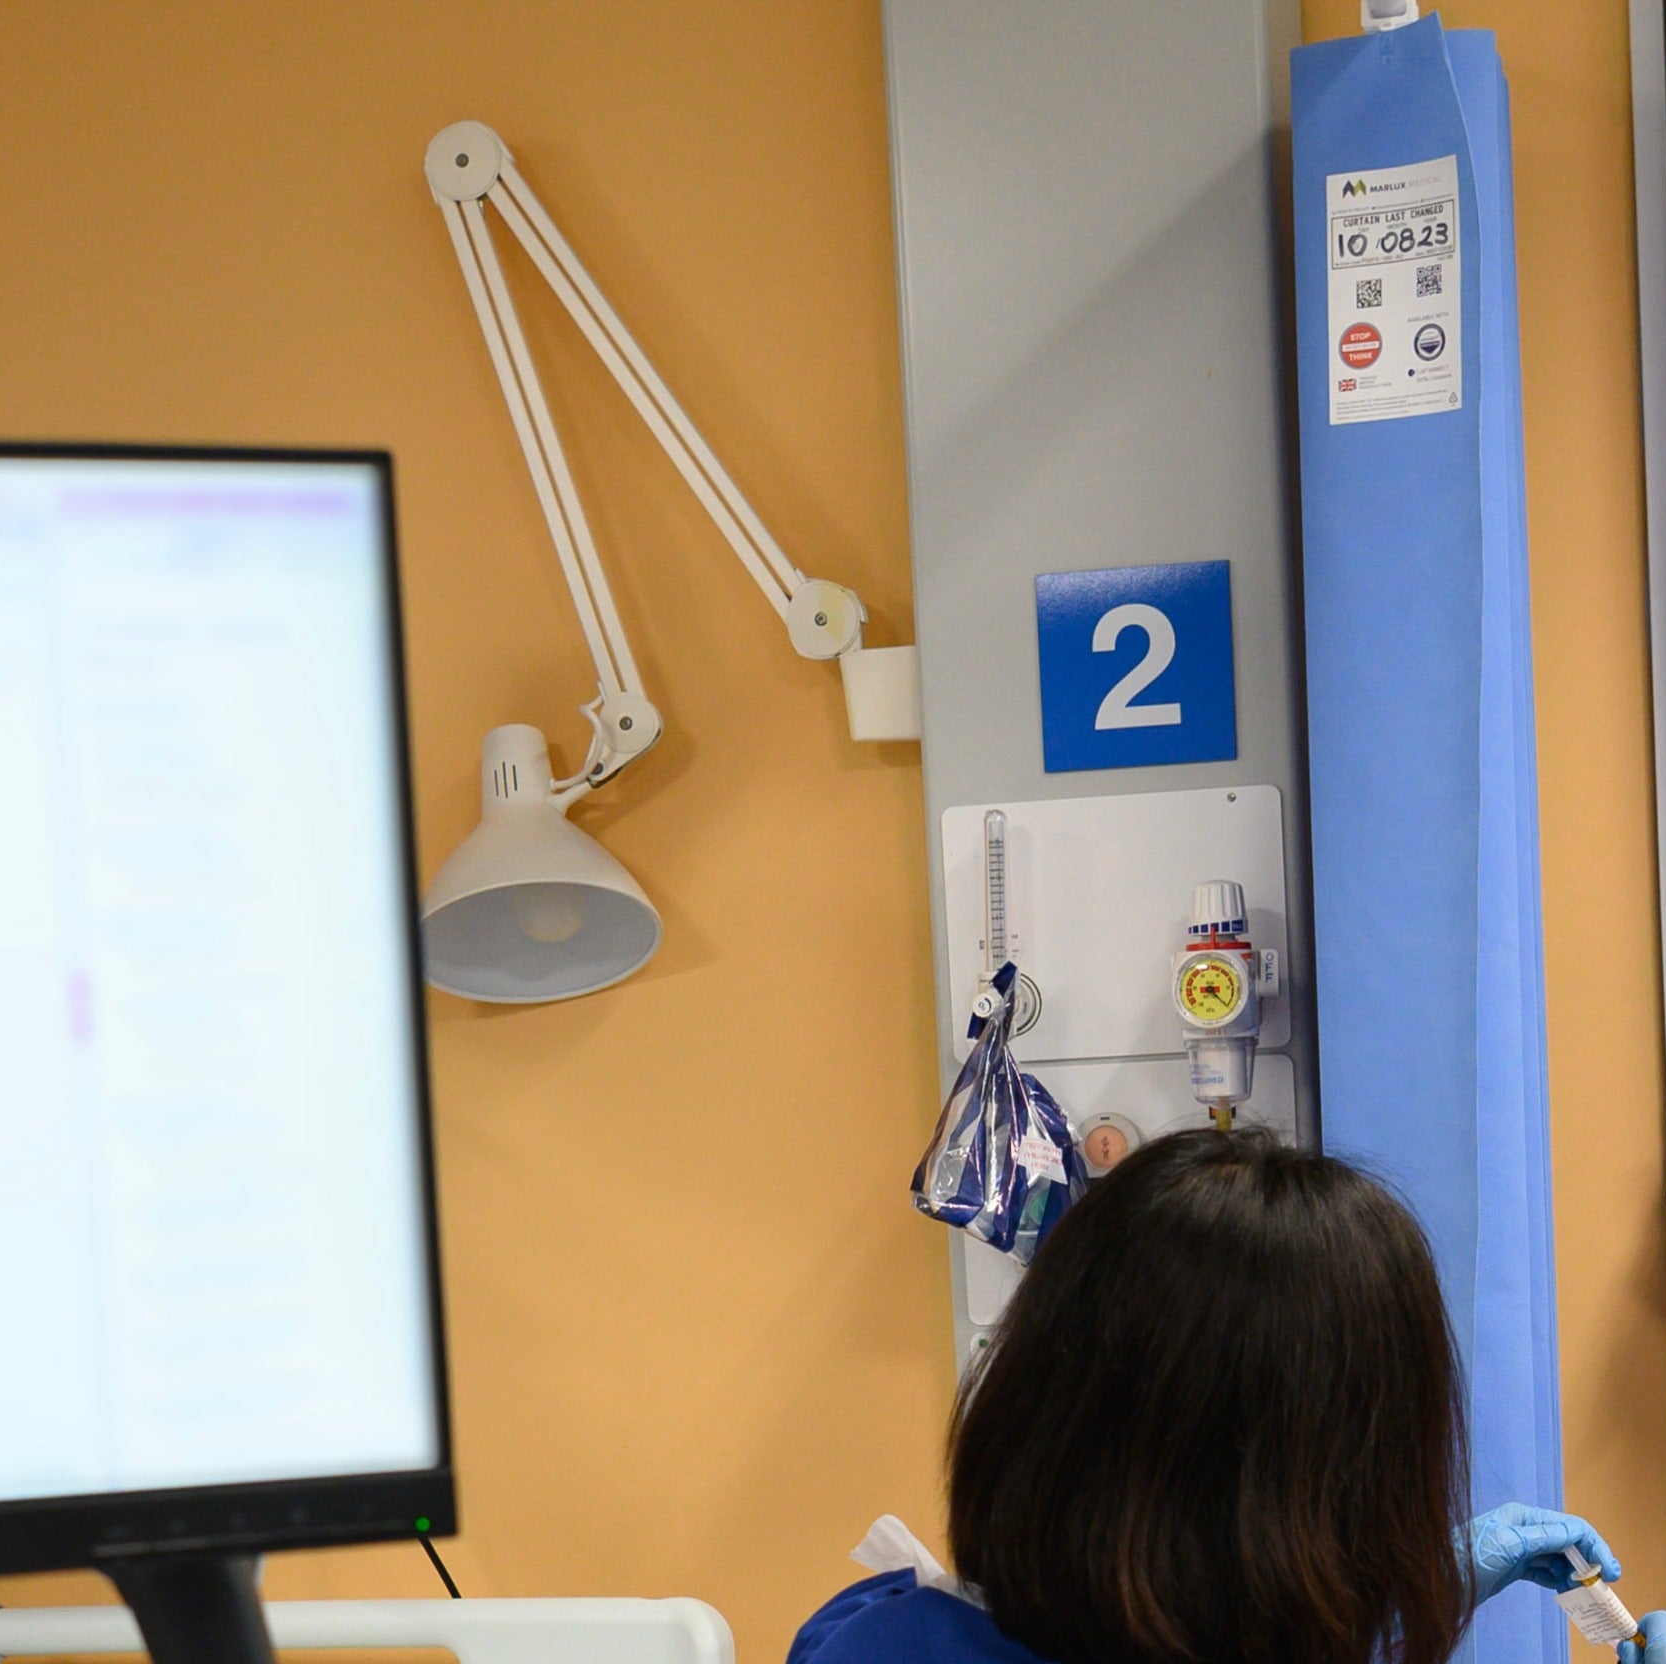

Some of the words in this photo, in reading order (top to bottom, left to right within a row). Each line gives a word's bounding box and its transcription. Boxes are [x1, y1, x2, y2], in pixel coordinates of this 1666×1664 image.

[1370, 182, 1406, 193] MARLUX
[1343, 215, 1380, 227] CURTAIN
[1385, 211, 1406, 222] LAST
[1410, 205, 1444, 219] CHANGED
[1338, 233, 1368, 258] 10
[1417, 222, 1449, 248] 23
[1350, 332, 1371, 341] STOP
[1349, 352, 1373, 361] THINK
[1091, 604, 1182, 731] 2
[1265, 952, 1274, 982] OFF
